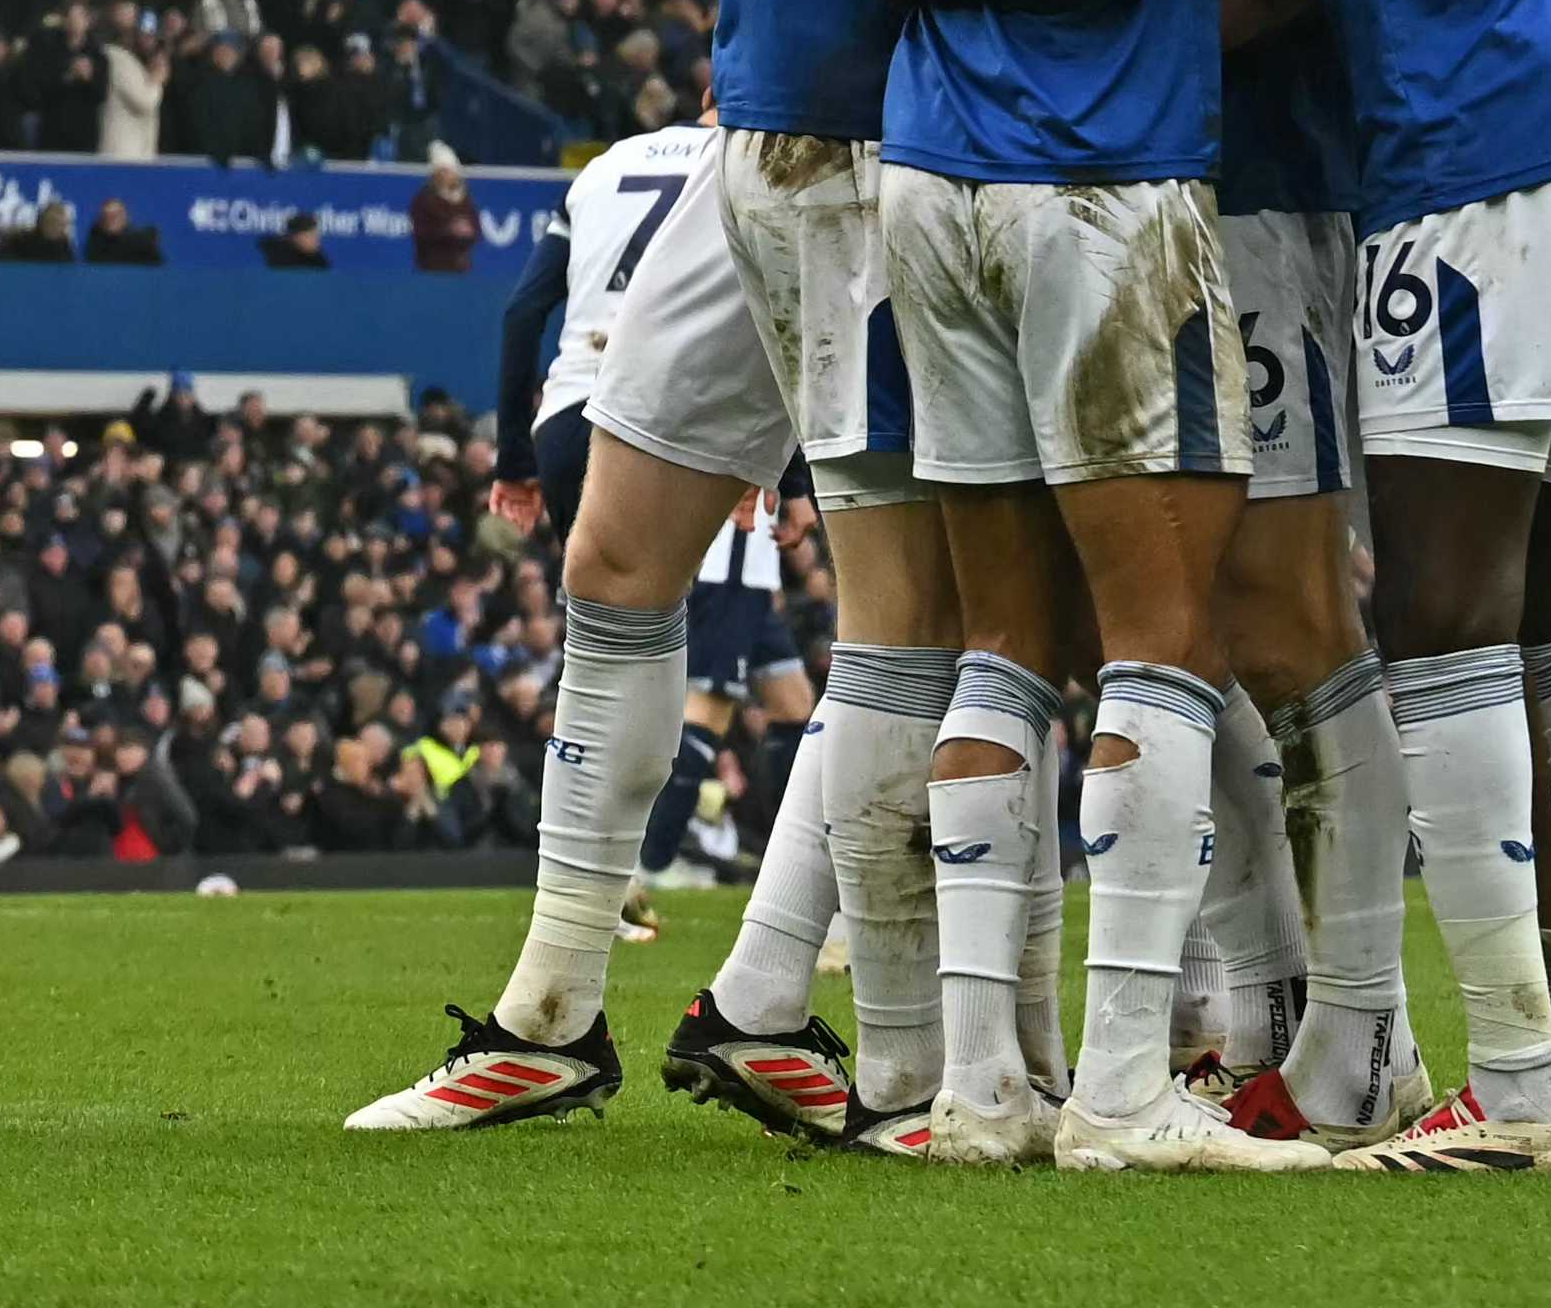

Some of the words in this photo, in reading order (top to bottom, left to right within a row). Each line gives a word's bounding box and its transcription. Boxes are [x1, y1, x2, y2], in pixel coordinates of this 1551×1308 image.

[646, 142, 697, 159] SON
[605, 173, 689, 292] 7
[1363, 241, 1433, 339] 16
[1355, 1011, 1393, 1126] TAPEDESIGN
